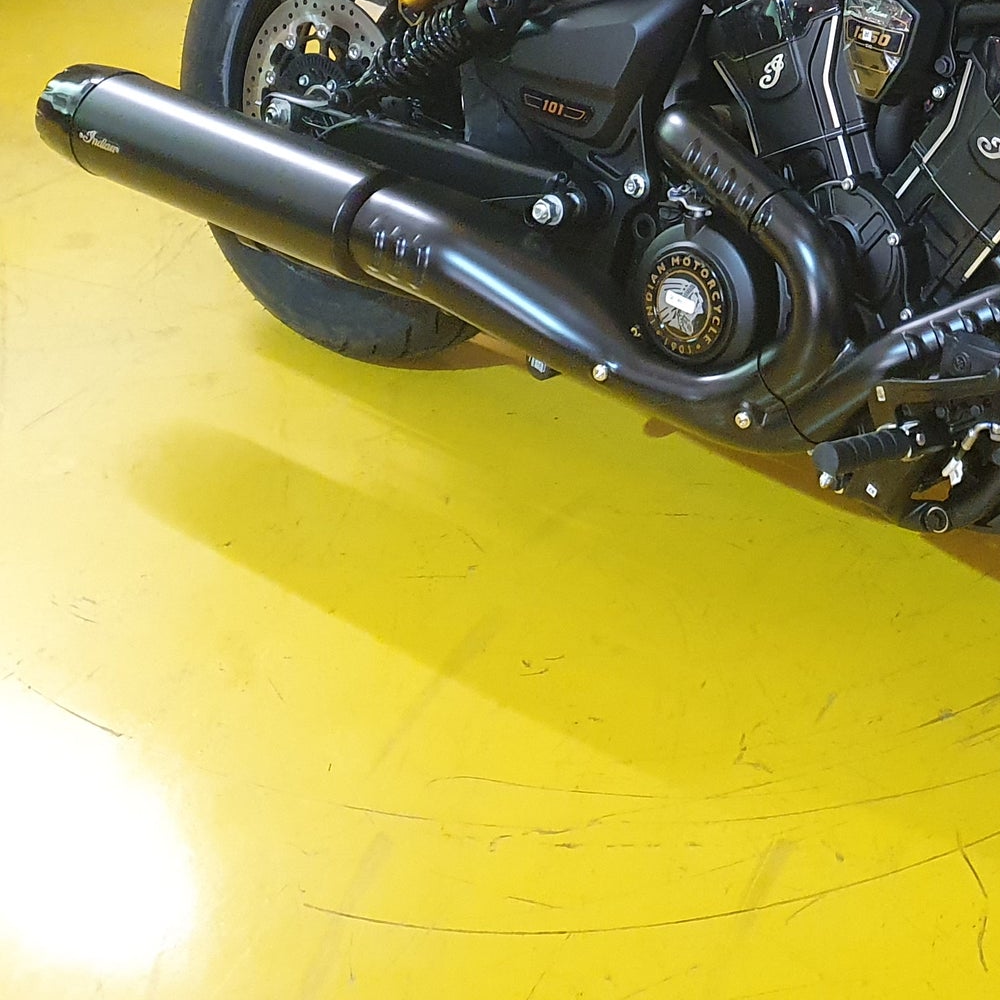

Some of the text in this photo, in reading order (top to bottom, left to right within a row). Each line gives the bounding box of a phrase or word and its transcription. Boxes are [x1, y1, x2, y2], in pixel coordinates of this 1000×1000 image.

[542, 99, 564, 116] 101
[80, 130, 119, 153] Indian
[645, 256, 722, 345] INDIAN MOTORCYCLE
